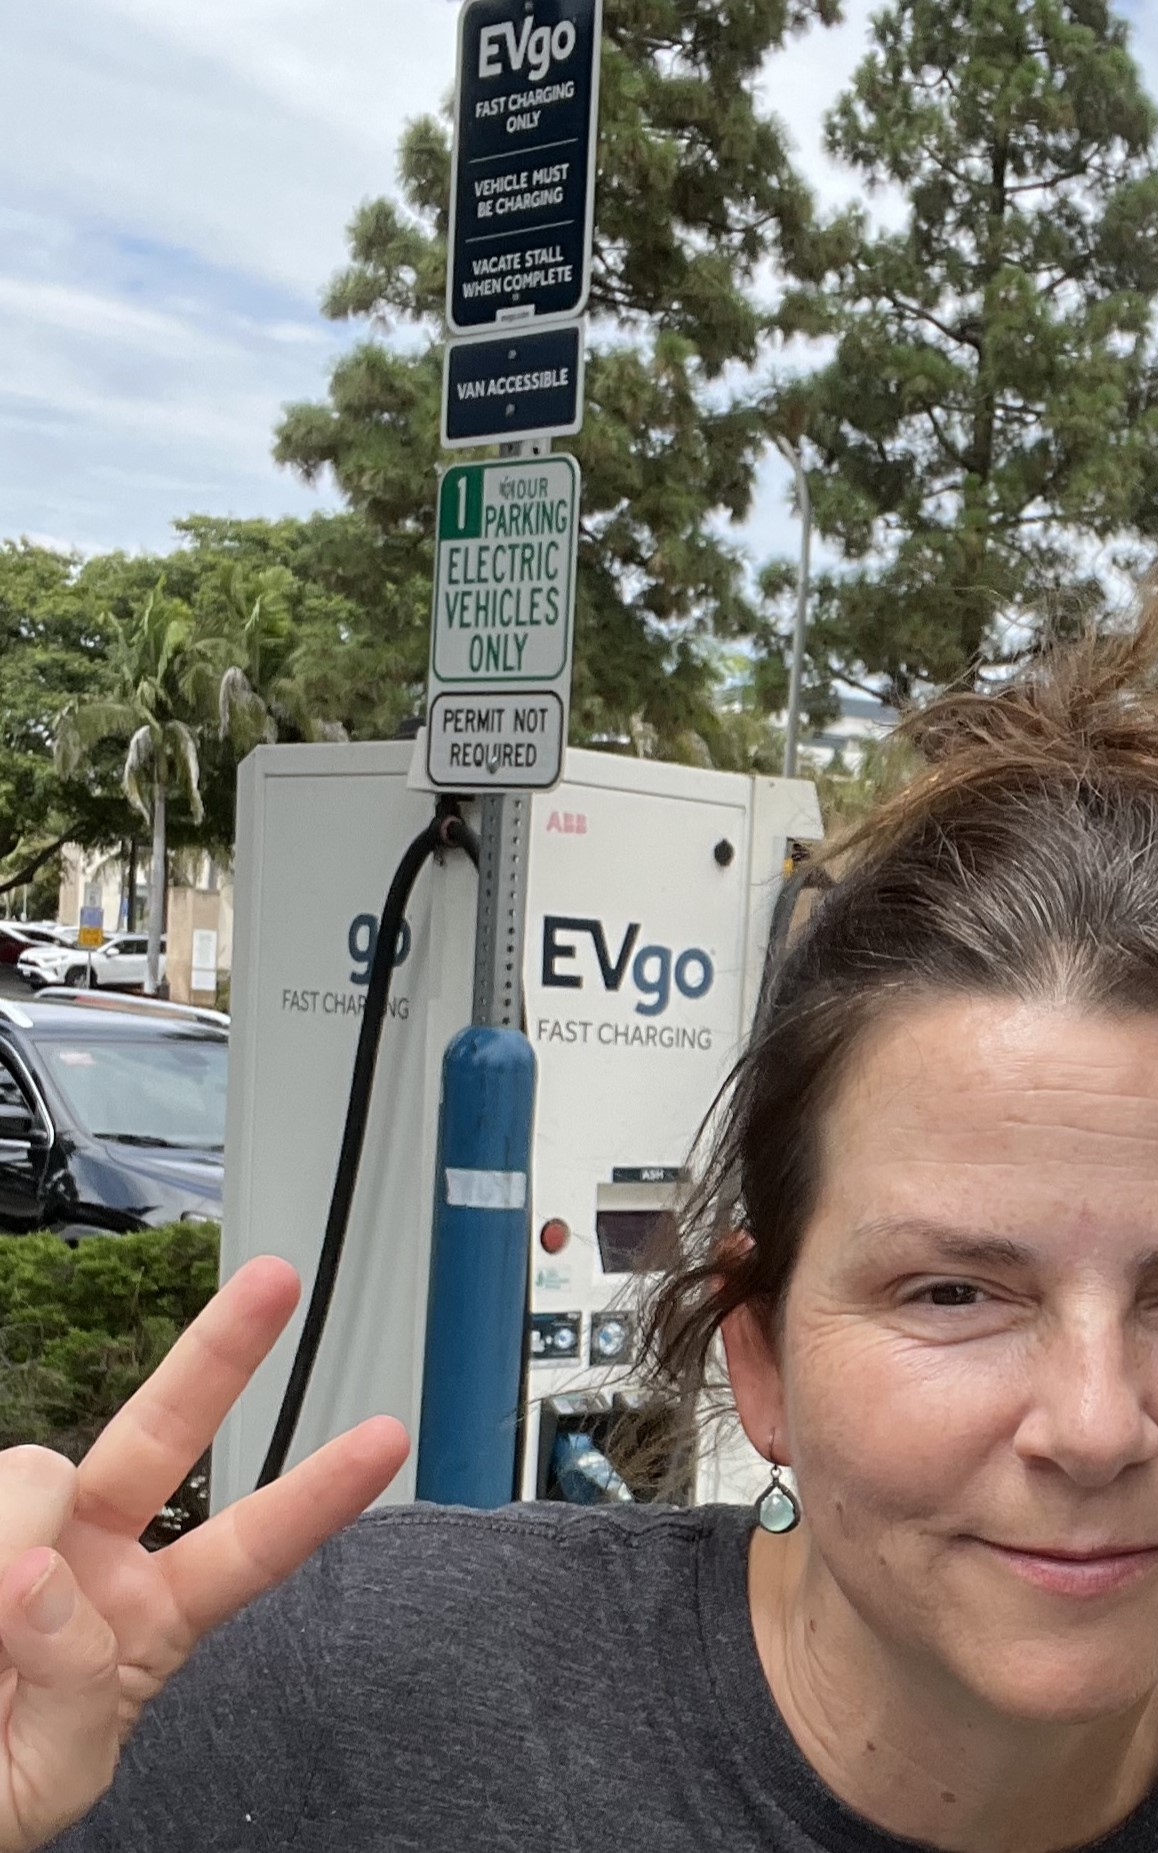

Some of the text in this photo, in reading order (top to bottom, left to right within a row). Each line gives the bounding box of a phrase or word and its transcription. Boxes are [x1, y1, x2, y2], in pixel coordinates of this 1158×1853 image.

[478, 15, 576, 80] EVgo
[475, 81, 575, 119] FAST CHARGING
[506, 110, 541, 133] ONLY
[474, 163, 569, 197] VEHICLE MUST
[477, 186, 564, 218] BE CHARGING
[472, 245, 564, 276] VACATE STALL
[462, 265, 573, 298] WHEN COMPLETE
[457, 367, 569, 400] VAN ACCESSIBLE
[457, 476, 467, 531] 1
[485, 499, 567, 538] PARKING
[447, 541, 560, 585] ELECTRIC
[445, 587, 560, 629] VEHICLES
[469, 633, 528, 673] ONLY
[443, 708, 549, 733] PERMIT NOT
[450, 743, 537, 768] REQUIRED
[546, 811, 588, 835] ABB
[541, 915, 714, 1016] EVgo
[282, 989, 409, 1020] FAST CHARNG
[537, 1018, 713, 1051] FAST CHARGING
